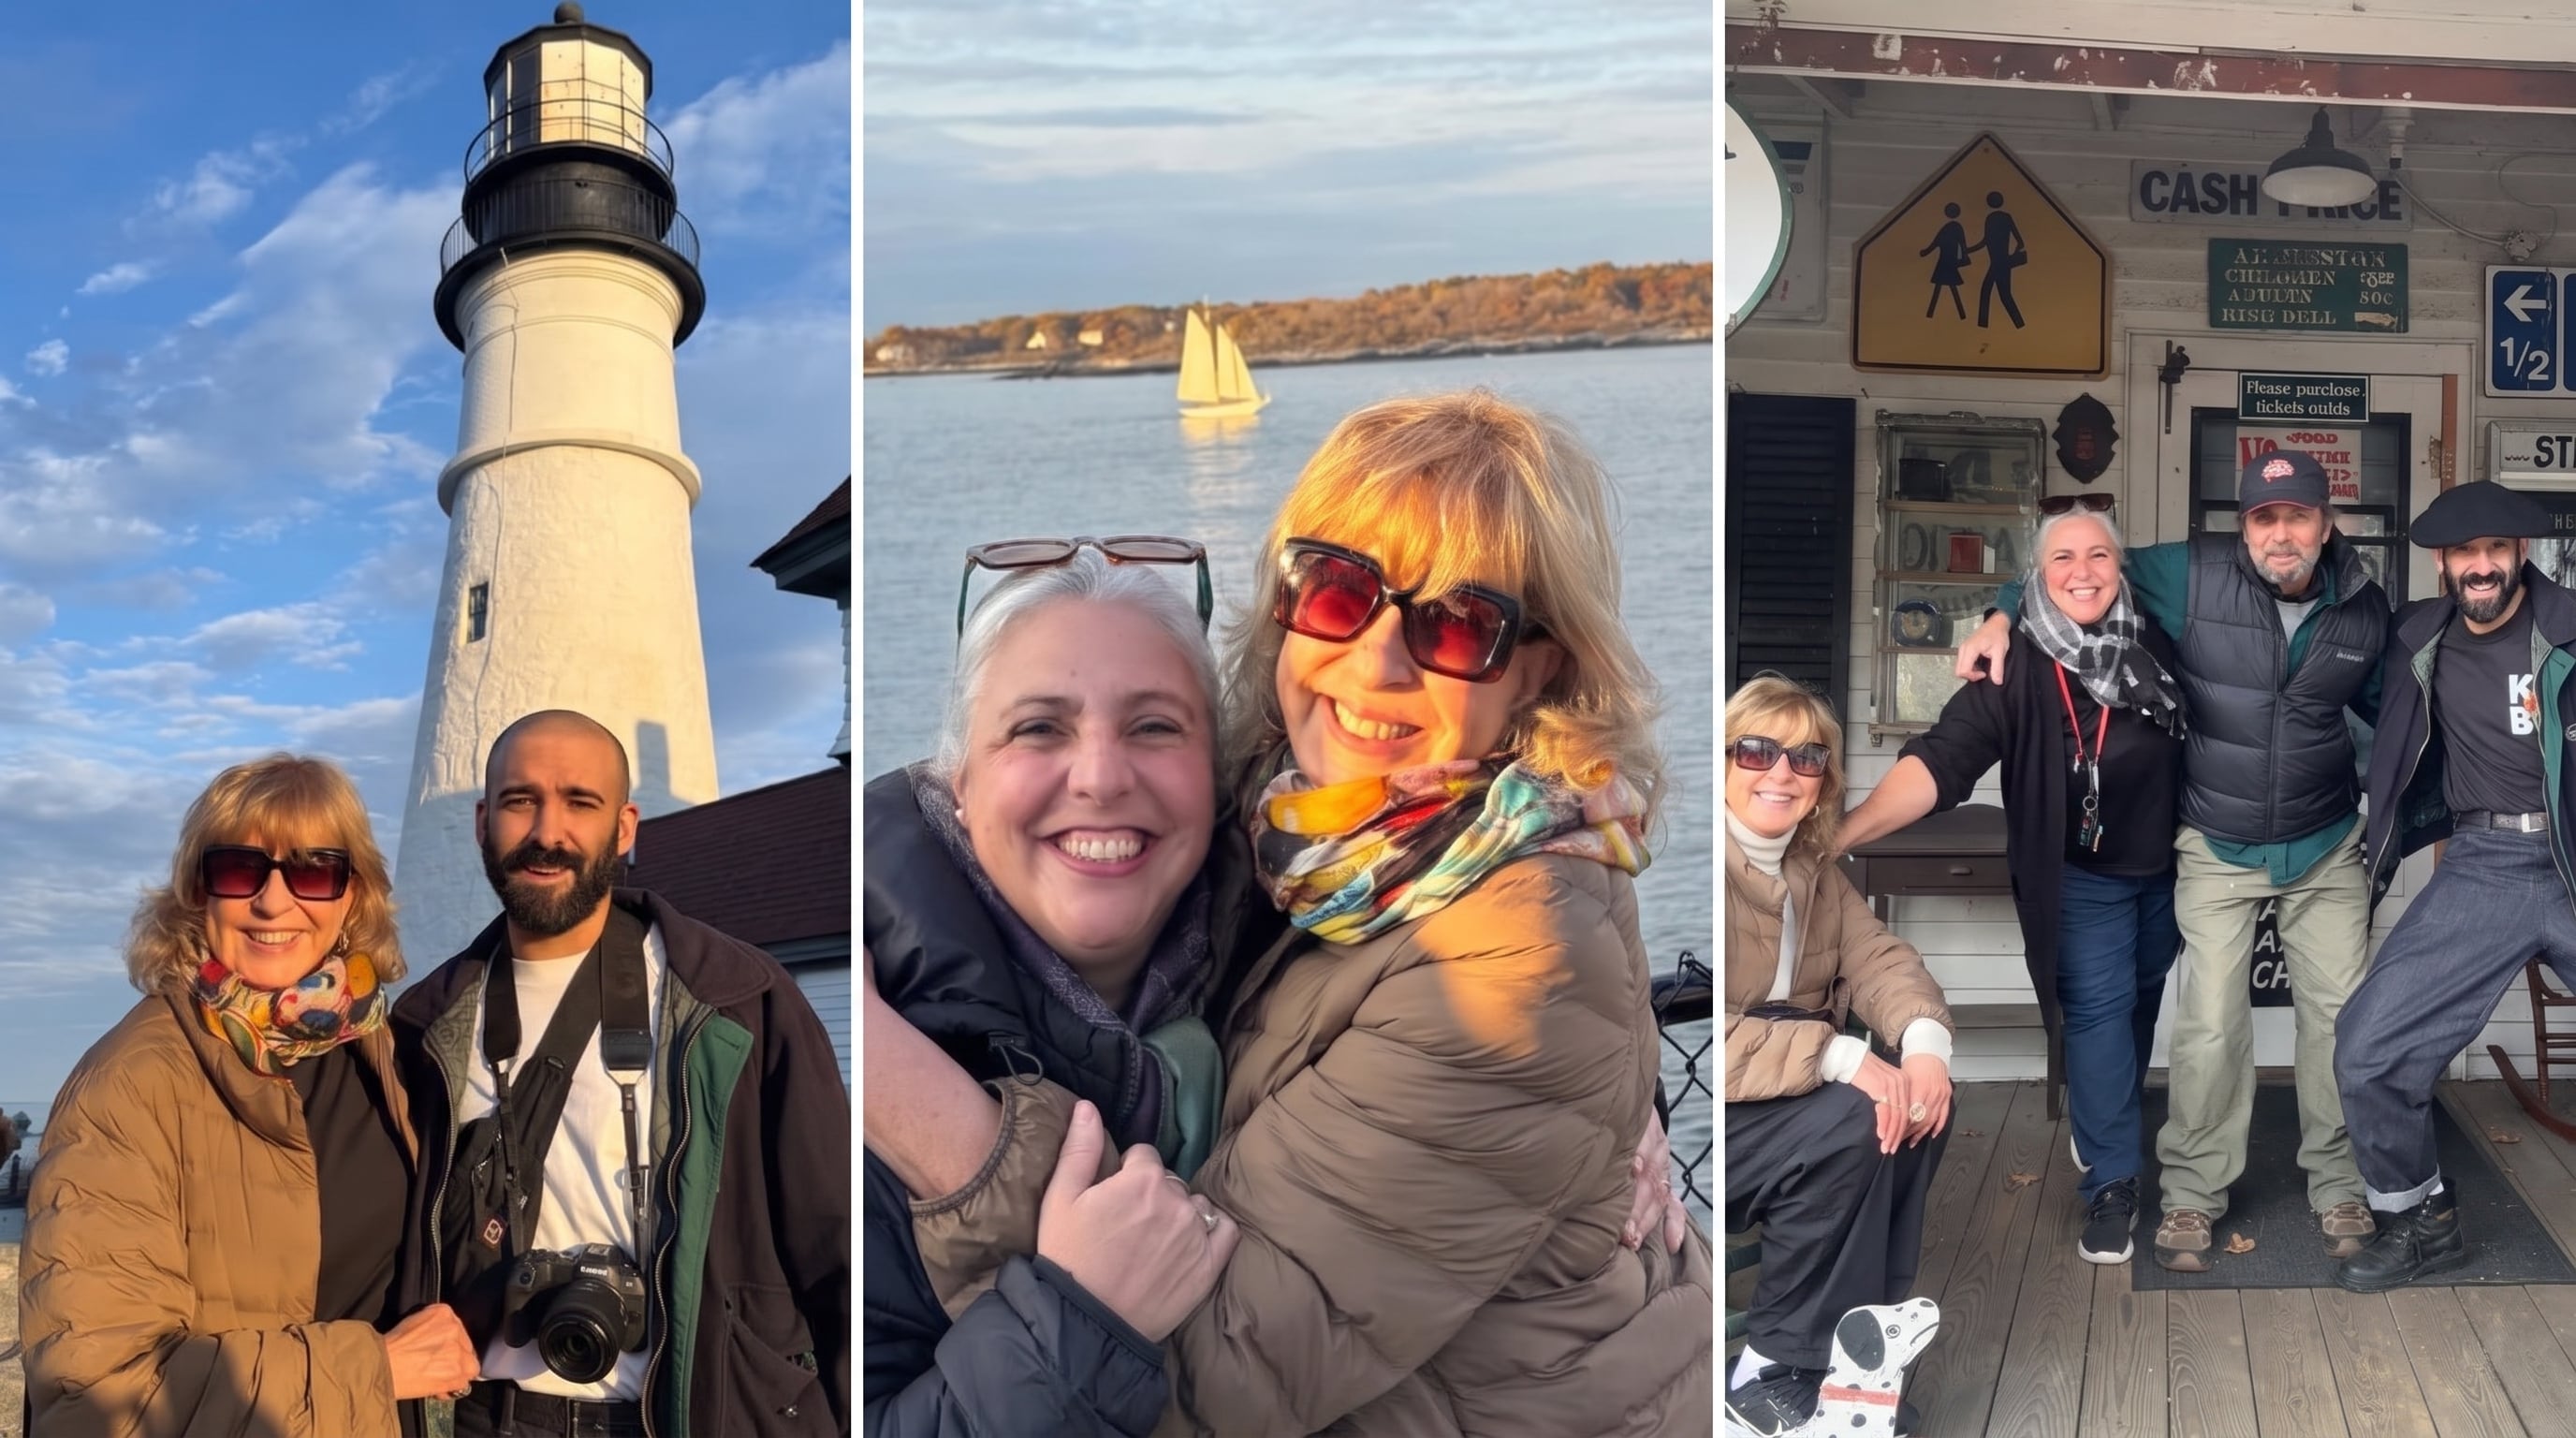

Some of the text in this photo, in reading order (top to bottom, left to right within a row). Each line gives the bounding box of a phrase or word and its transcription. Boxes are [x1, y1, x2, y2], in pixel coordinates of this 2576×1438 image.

[2140, 170, 2258, 215] CASH
[2500, 337, 2550, 381] 1/2
[2534, 435, 2576, 468] ST
